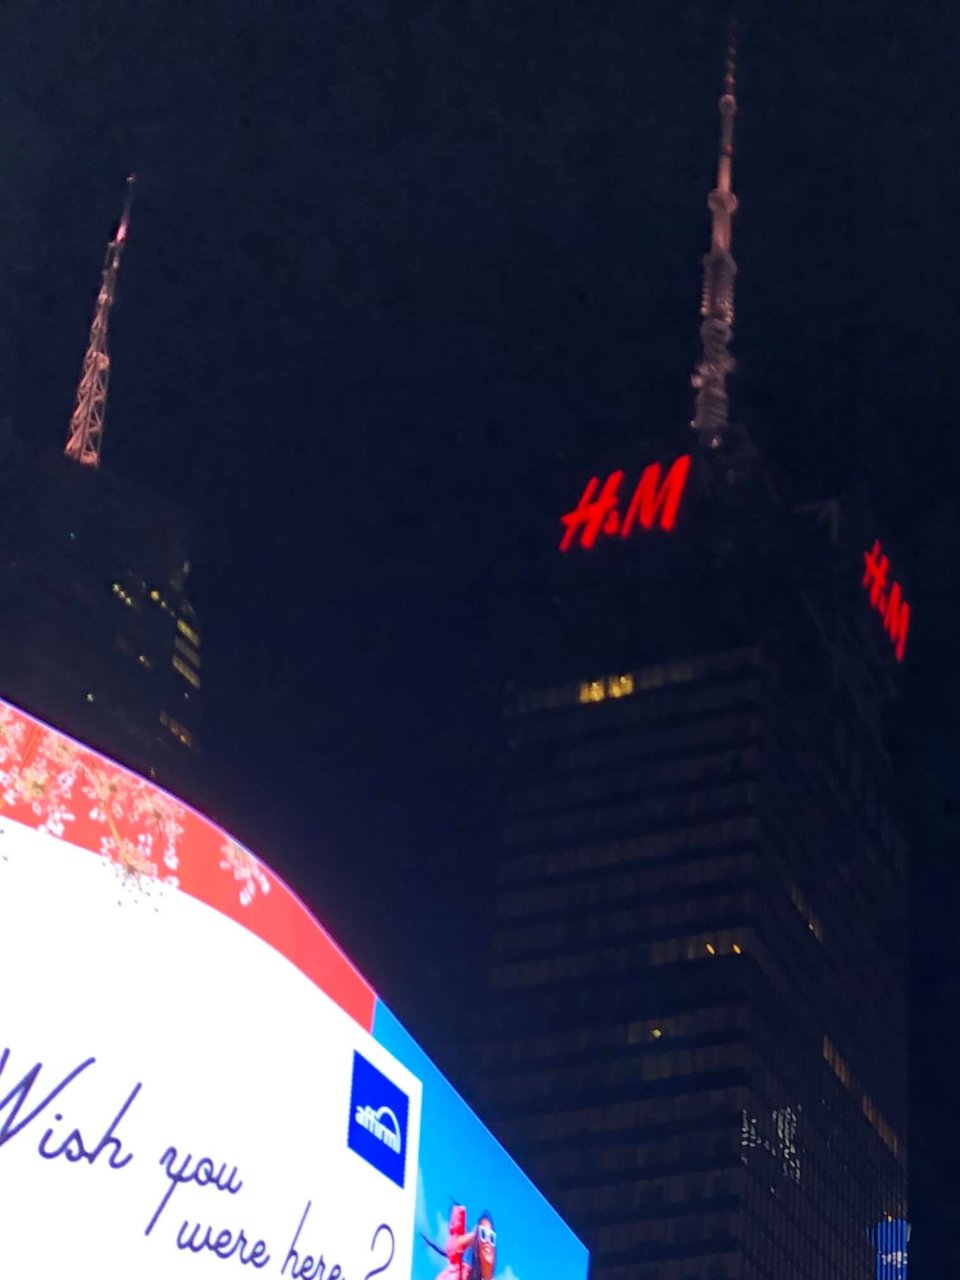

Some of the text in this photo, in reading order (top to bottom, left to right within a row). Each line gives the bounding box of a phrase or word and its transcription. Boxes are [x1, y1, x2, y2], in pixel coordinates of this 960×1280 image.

[558, 454, 692, 552] H&M
[355, 1103, 402, 1155] affirm
[145, 1146, 243, 1236] you
[177, 1220, 271, 1269] were
